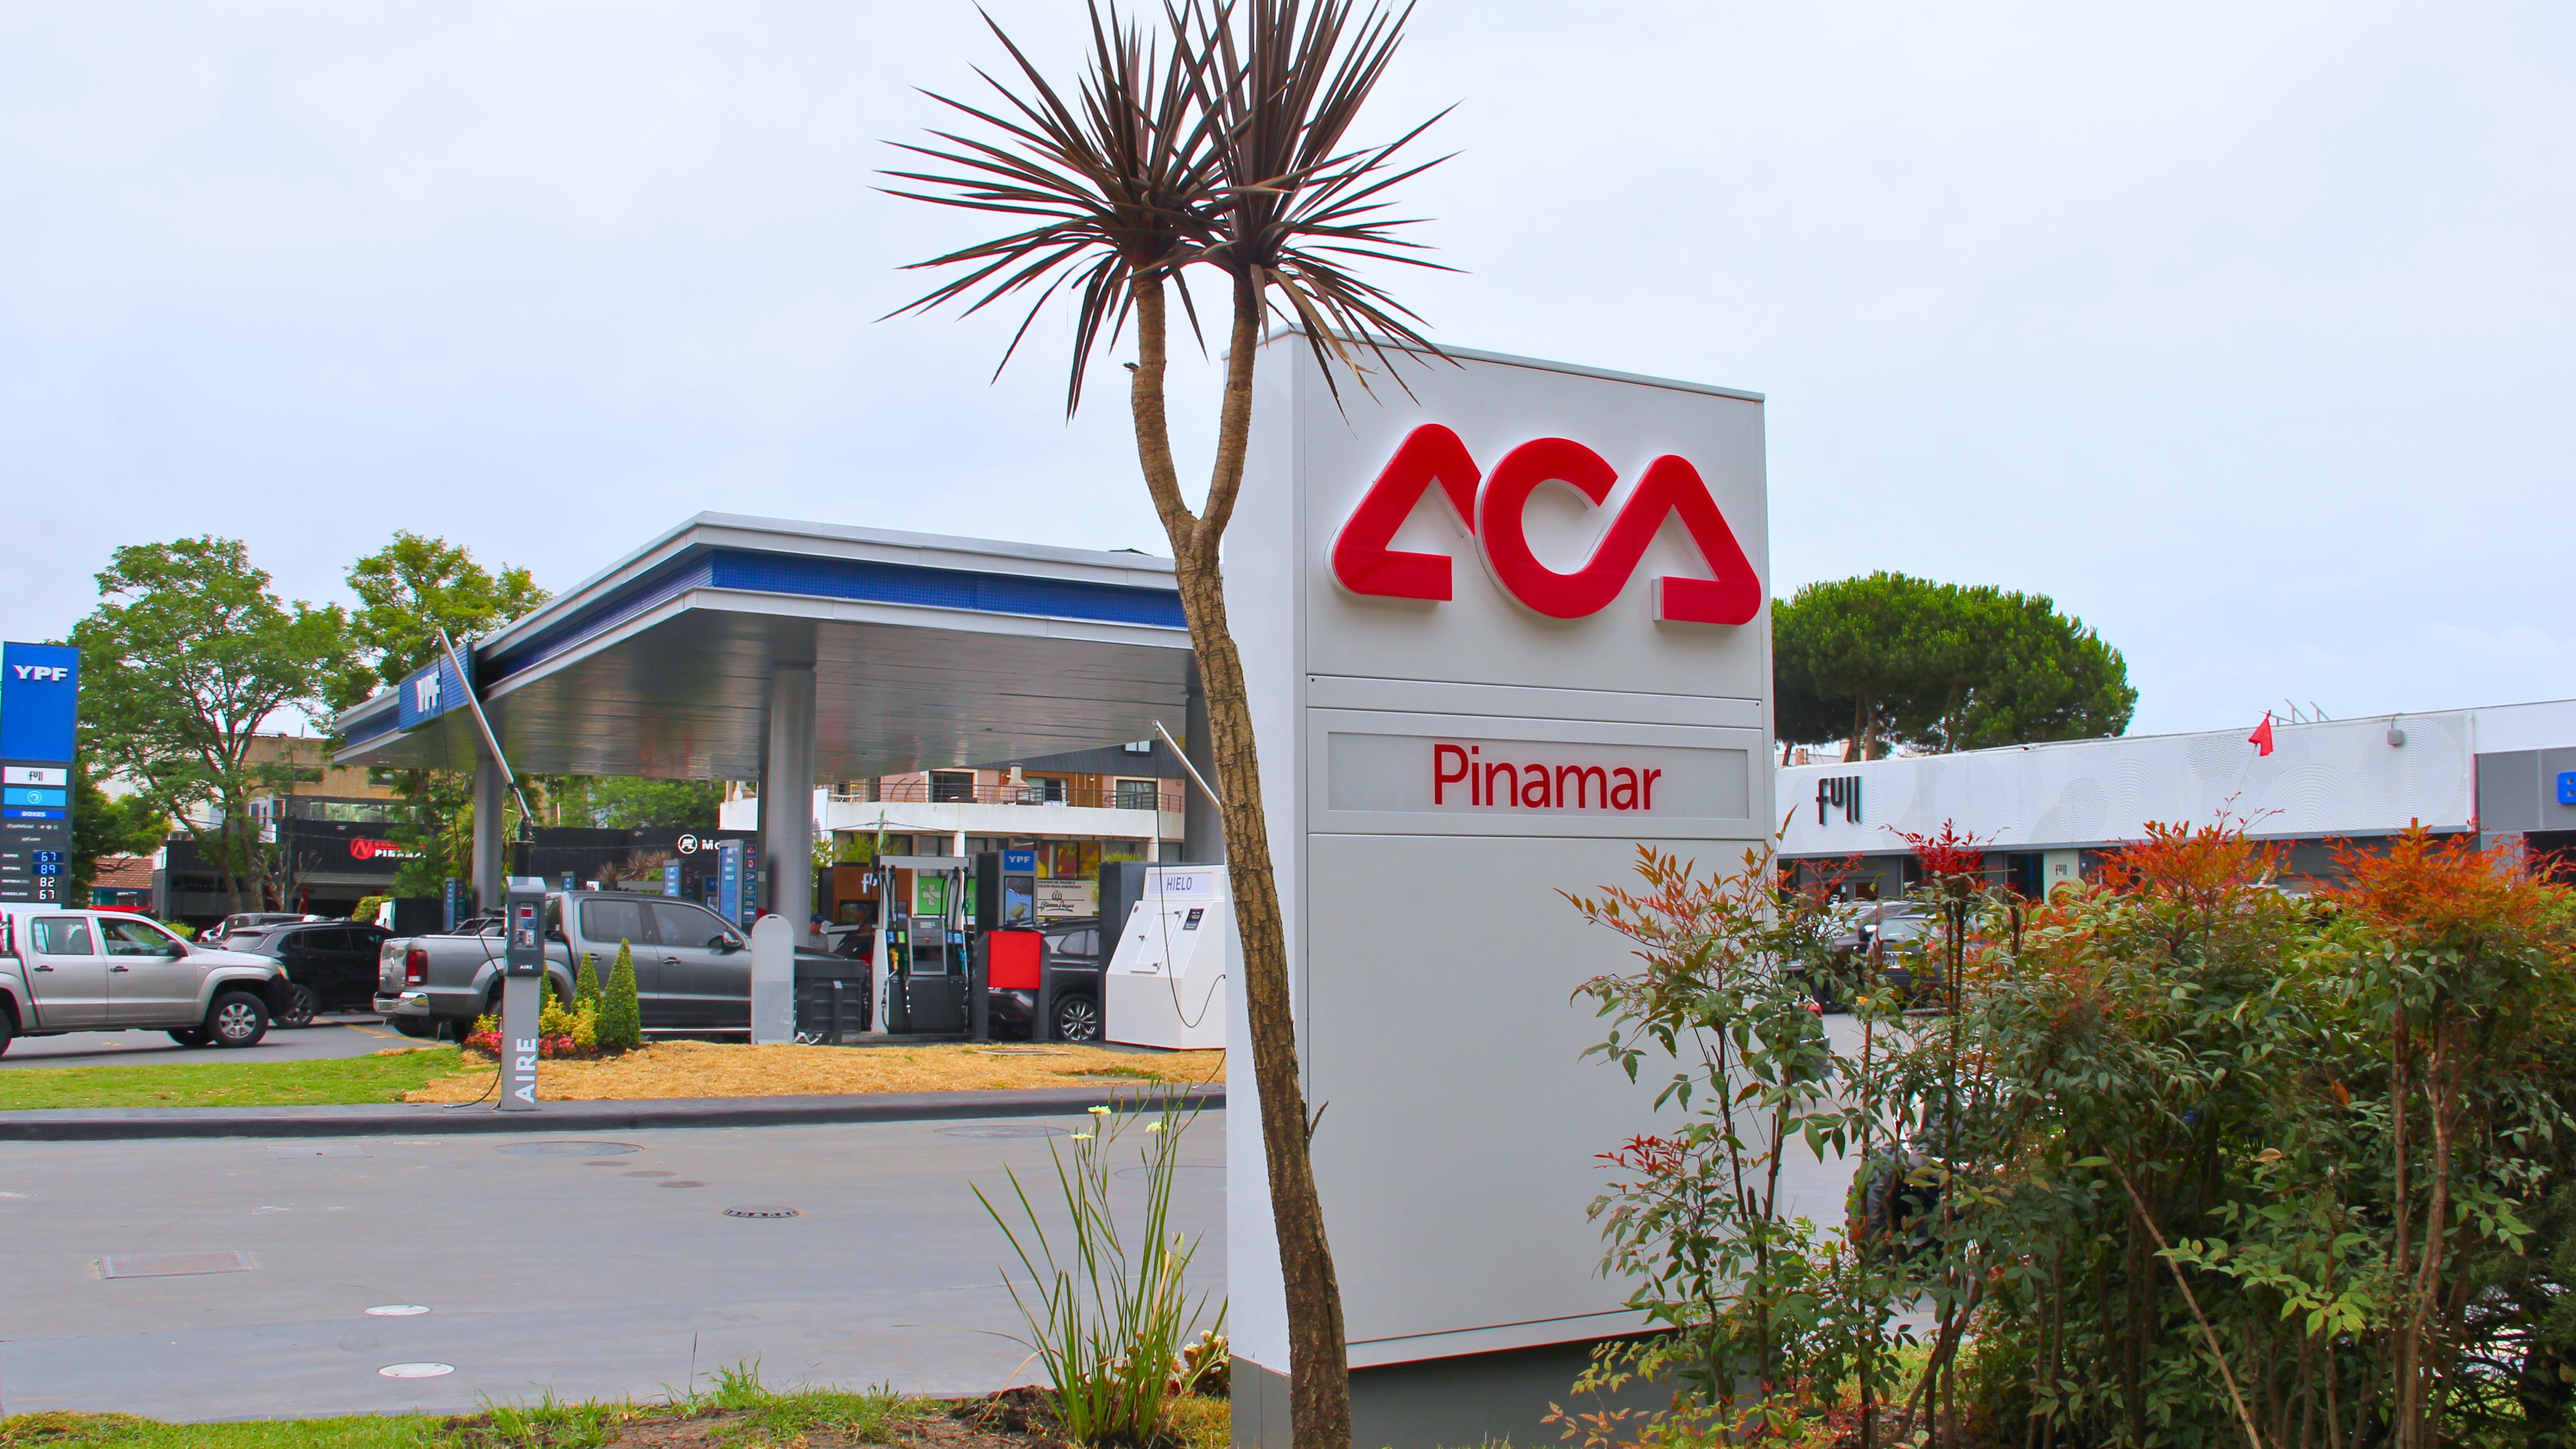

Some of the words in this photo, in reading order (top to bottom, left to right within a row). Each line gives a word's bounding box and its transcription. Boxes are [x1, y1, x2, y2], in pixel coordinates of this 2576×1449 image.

[1331, 422, 1762, 626] ACA
[12, 664, 68, 681] YPF
[416, 671, 440, 713] YPF
[29, 771, 43, 781] full
[1433, 743, 1662, 811] Pinamar
[1815, 776, 1862, 826] full
[41, 851, 56, 862] 67
[41, 864, 56, 875] 89
[2055, 864, 2067, 876] full
[39, 877, 55, 887] 82
[1166, 876, 1193, 891] HIELO
[39, 889, 55, 900] 67
[515, 1037, 537, 1104] AIRE
